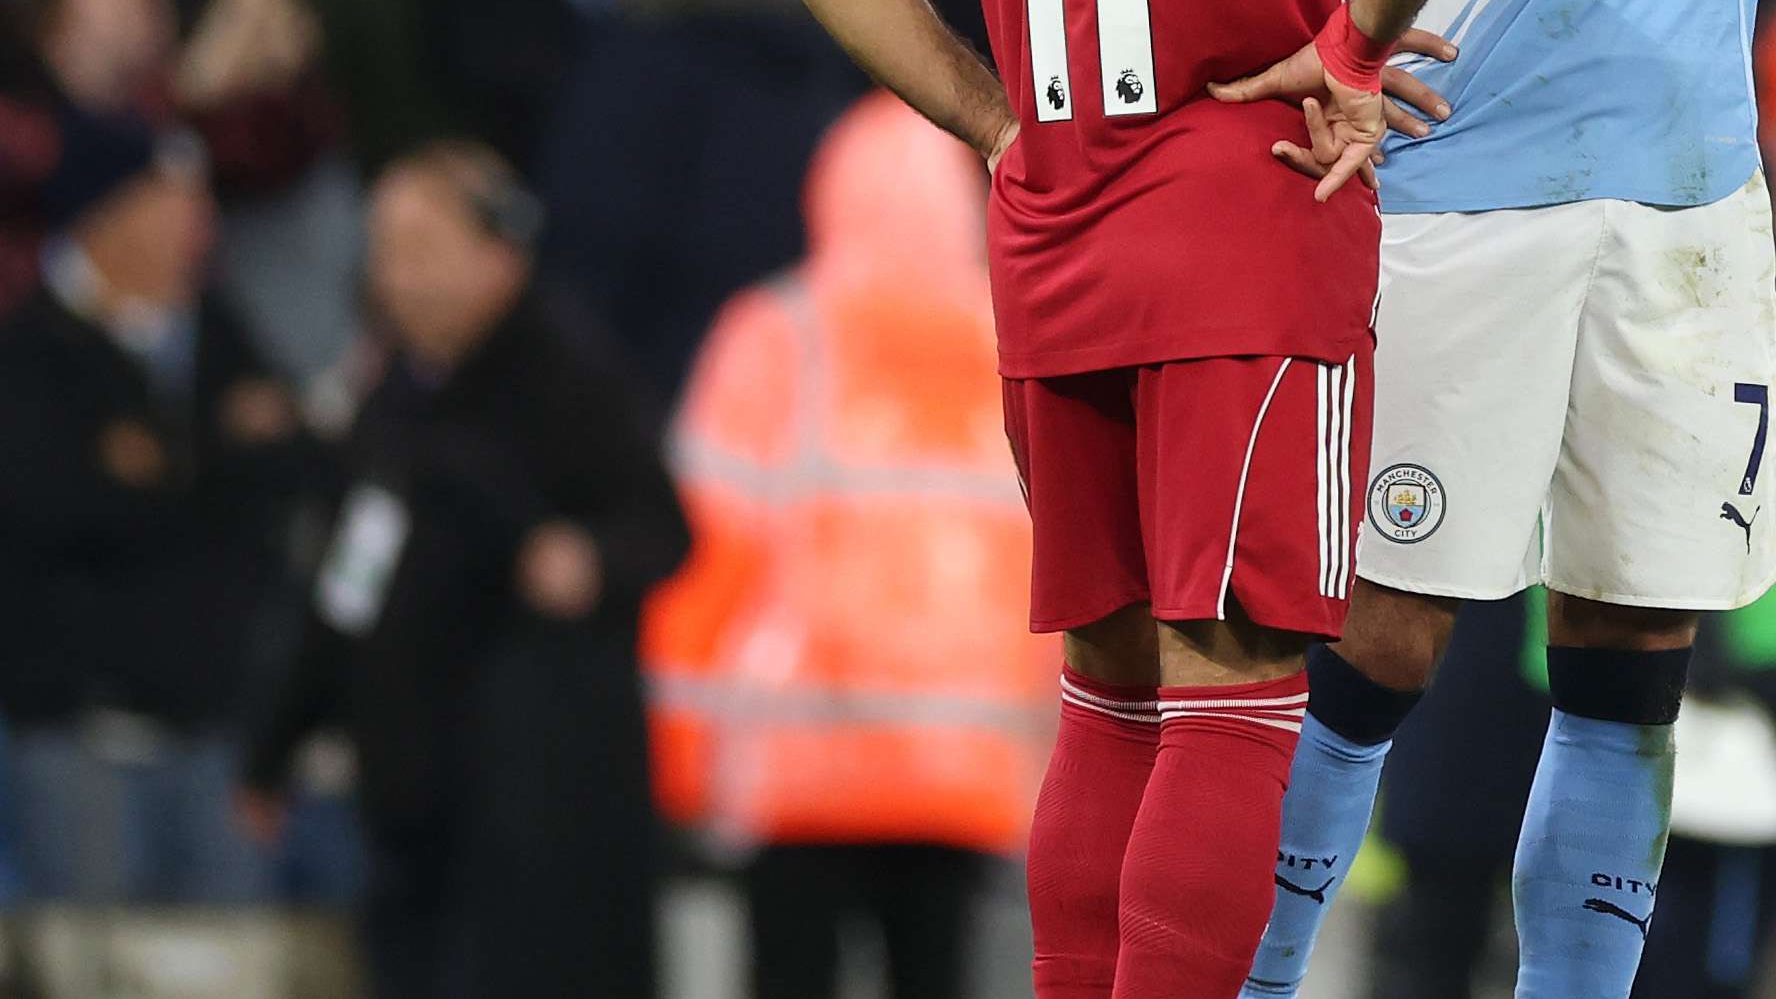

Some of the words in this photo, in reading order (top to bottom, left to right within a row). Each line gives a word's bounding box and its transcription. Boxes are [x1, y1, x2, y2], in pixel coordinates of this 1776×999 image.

[1734, 382, 1768, 495] 7
[1376, 469, 1438, 494] MANCHESTER
[1394, 529, 1418, 538] CITY
[1591, 873, 1656, 896] CITY
